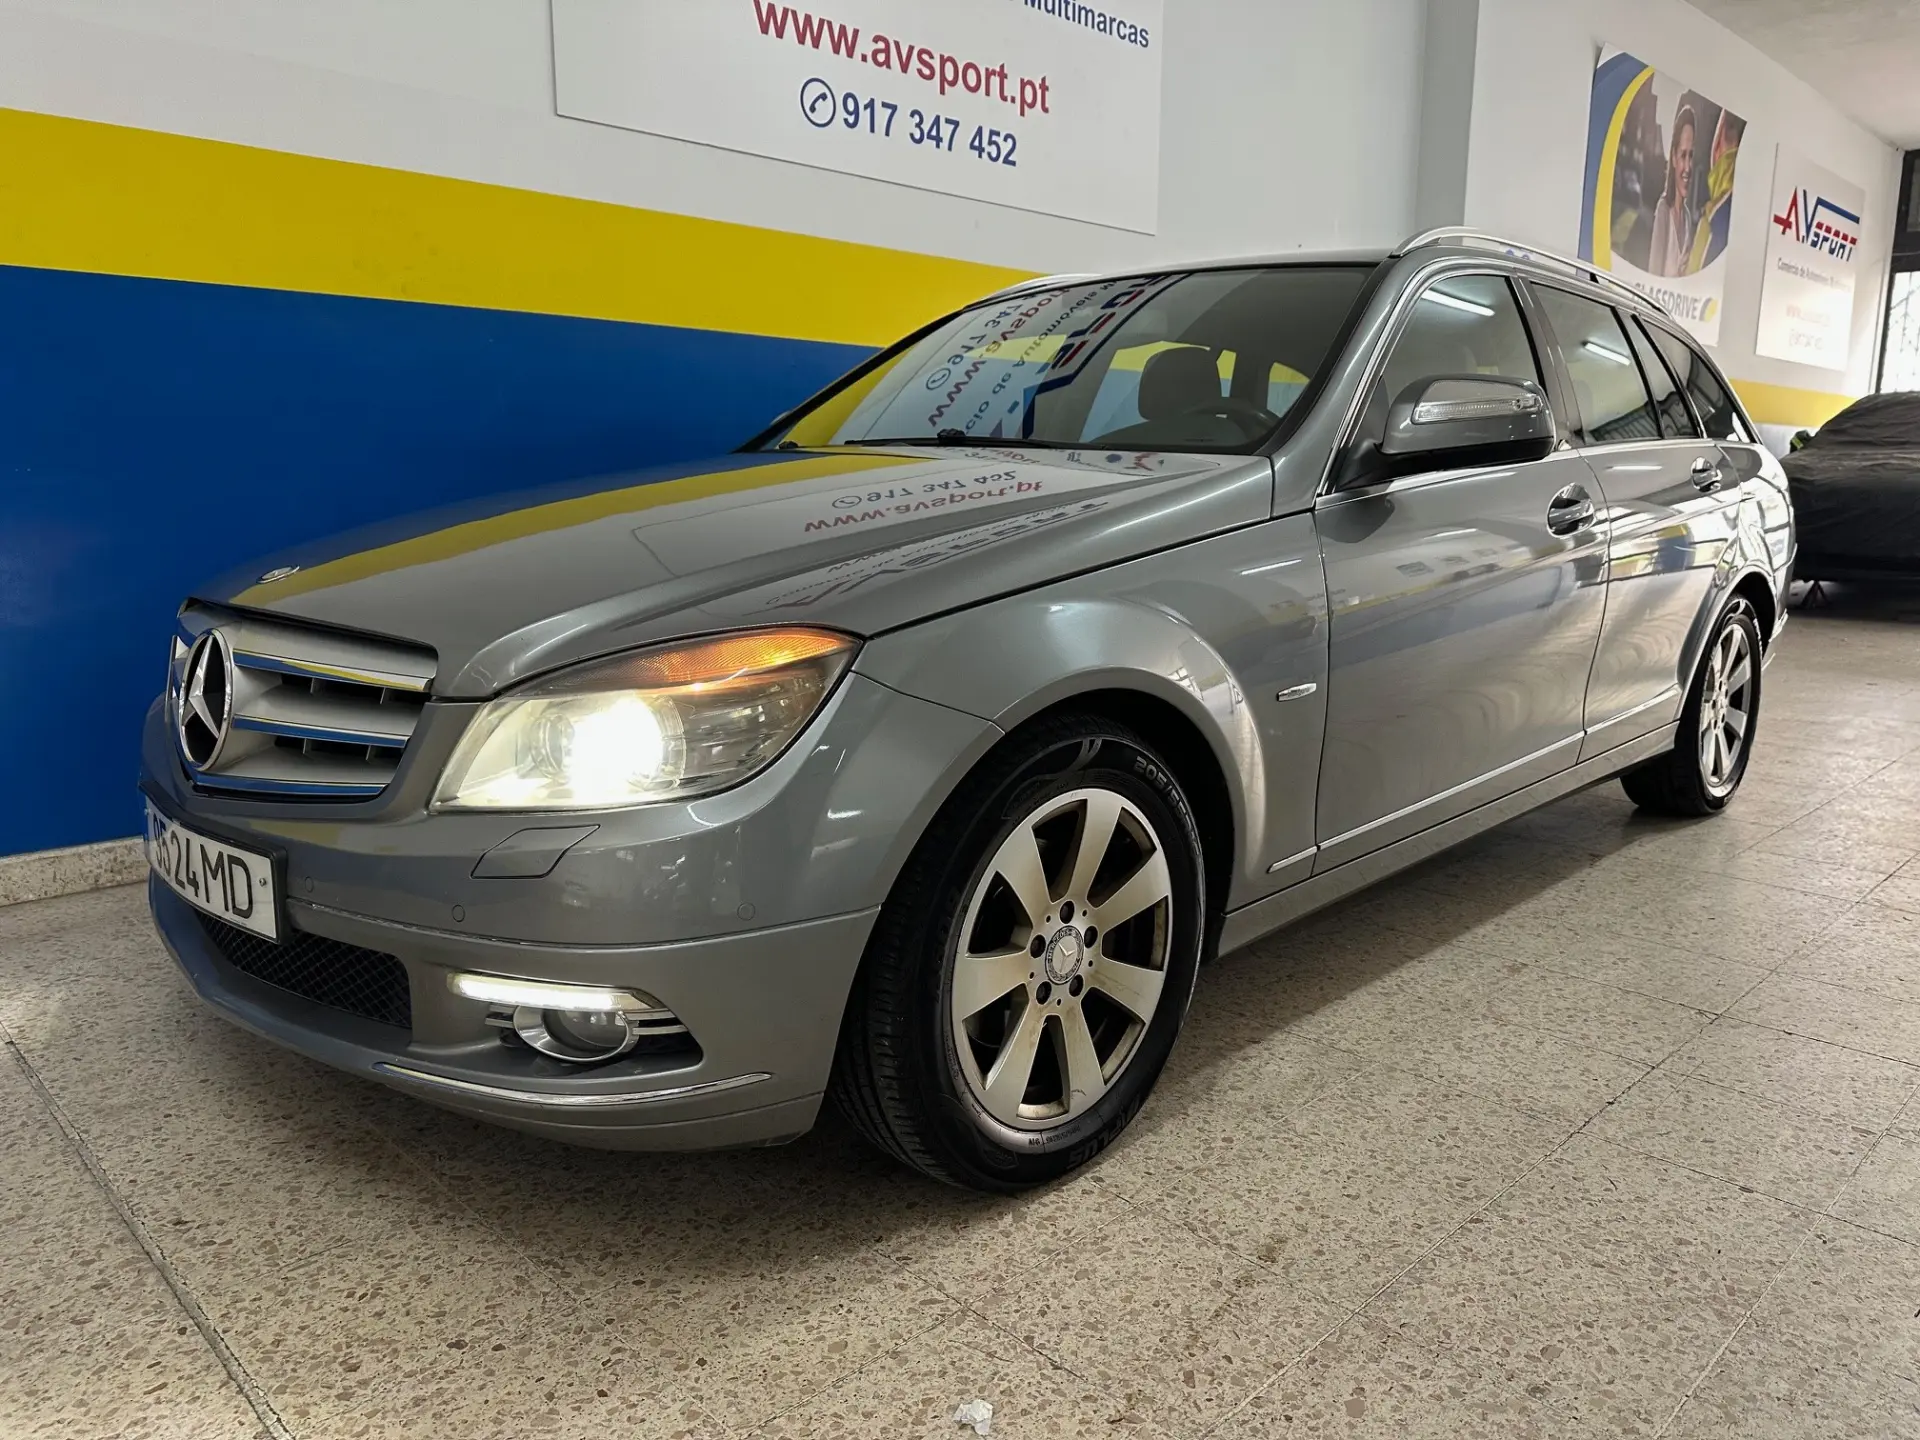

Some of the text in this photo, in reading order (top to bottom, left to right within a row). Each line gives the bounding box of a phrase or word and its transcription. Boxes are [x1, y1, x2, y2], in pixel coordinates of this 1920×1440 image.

[753, 0, 1050, 116] www.avsport.pt
[1024, 0, 1149, 48] ultimarcas
[842, 92, 1018, 167] 917 347 452
